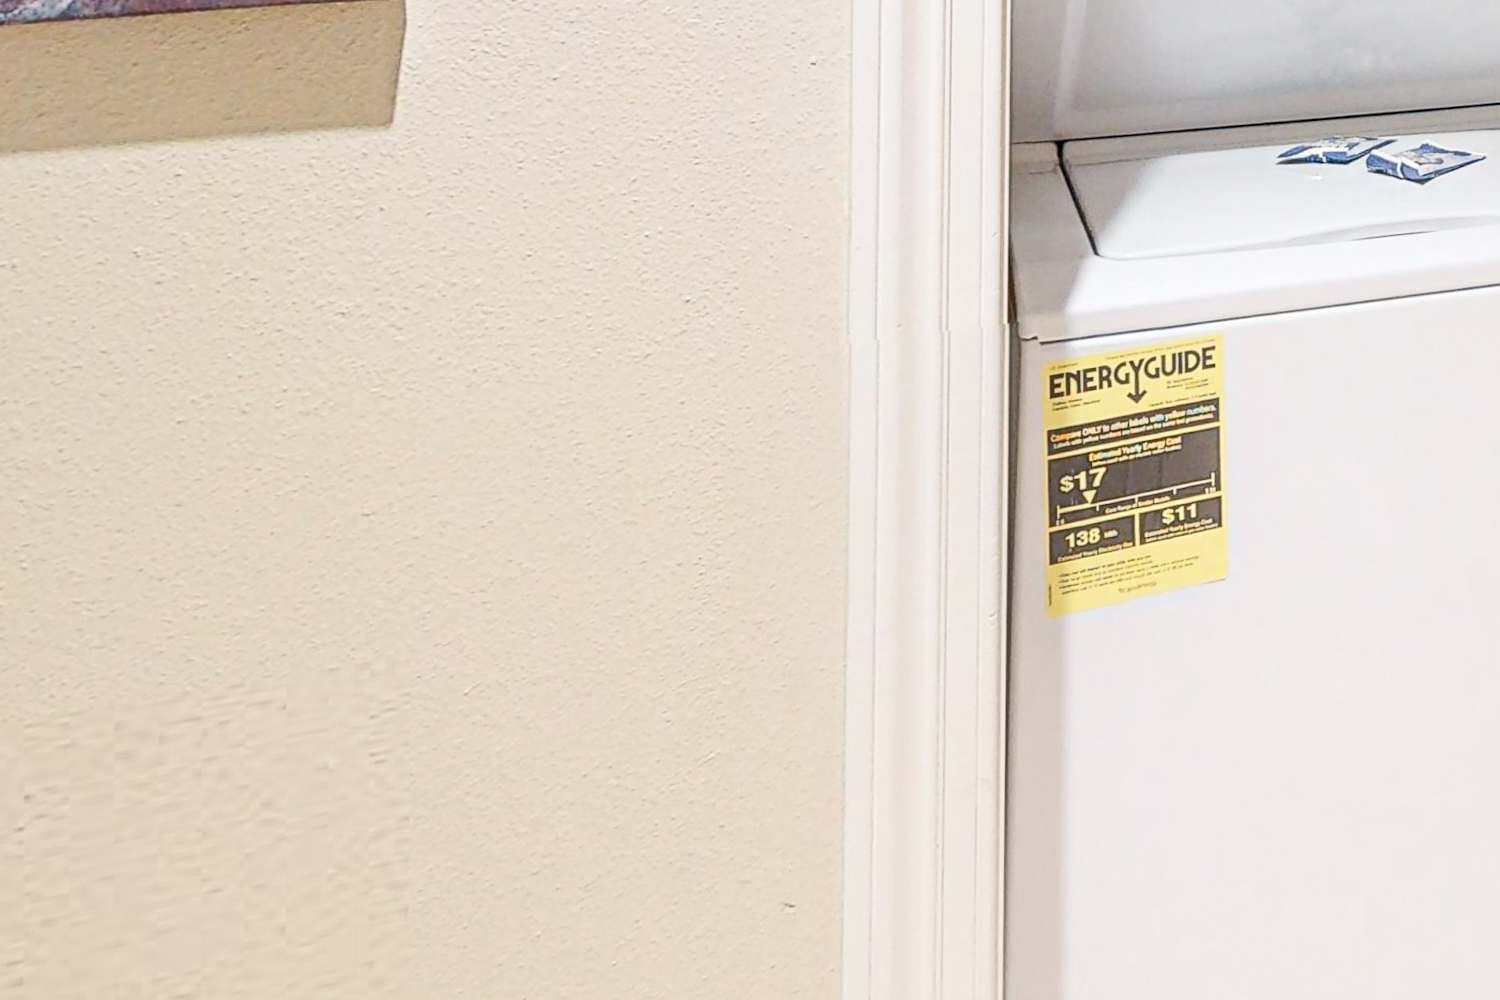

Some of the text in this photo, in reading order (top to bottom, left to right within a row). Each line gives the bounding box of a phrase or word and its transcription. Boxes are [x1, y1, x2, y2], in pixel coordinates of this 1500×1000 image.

[1049, 346, 1216, 402] ENERGYGUIDE
[1082, 424, 1102, 436] ONLY
[1110, 420, 1129, 430] other
[1129, 416, 1149, 427] labels
[1149, 414, 1165, 423] with
[1164, 409, 1186, 422] yellow
[1059, 466, 1107, 493] $17
[1161, 502, 1198, 525] $11
[1065, 527, 1101, 549] 138
